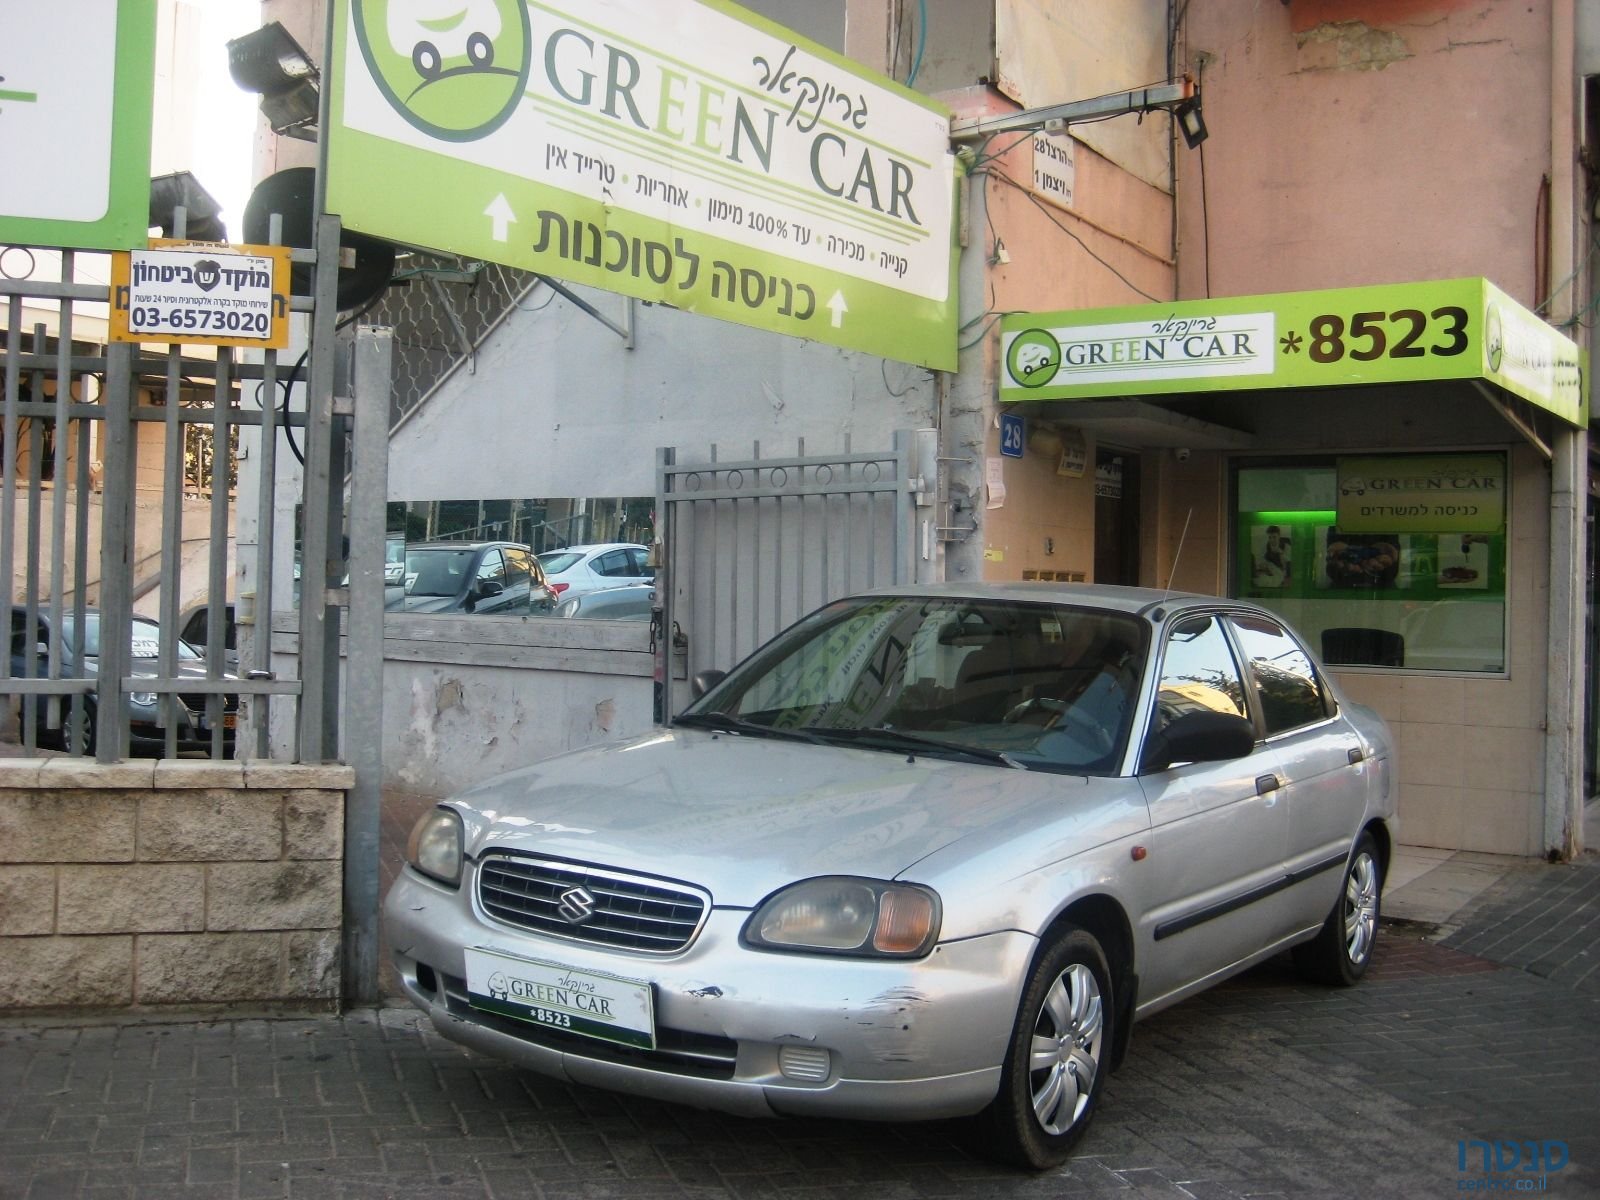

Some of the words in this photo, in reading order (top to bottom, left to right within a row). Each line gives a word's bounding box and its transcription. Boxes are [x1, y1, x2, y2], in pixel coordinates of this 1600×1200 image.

[753, 46, 868, 132] גרינקאר
[545, 28, 780, 173] GREEN
[809, 133, 922, 225] CAR
[546, 143, 568, 170] אין
[573, 151, 616, 184] טרייד
[1035, 169, 1039, 183] 1
[1043, 172, 1065, 194] ויצמן
[636, 174, 689, 208] אחריות
[708, 198, 743, 225] מימון
[748, 211, 788, 239] 100%
[792, 223, 811, 245] עד
[533, 210, 700, 290] לסוכנות
[827, 235, 865, 261] מכירה
[880, 251, 908, 278] קנייה
[135, 294, 152, 303] שעות
[153, 294, 162, 303] 24
[213, 298, 231, 308] בקרה
[711, 259, 817, 321] כניסה
[232, 299, 248, 308] מוקד
[132, 307, 269, 332] 03-6573020
[1151, 313, 1217, 342] גרינקאר
[1065, 337, 1166, 366] GREEN
[1183, 332, 1256, 358] CAR
[1003, 423, 1021, 449] 28
[1370, 477, 1442, 490] GREEN
[1452, 477, 1496, 490] CAR
[1360, 503, 1429, 517] למשרדים
[1434, 505, 1478, 517] כניסה
[511, 979, 569, 1006] GREEN
[575, 994, 613, 1016] CAR
